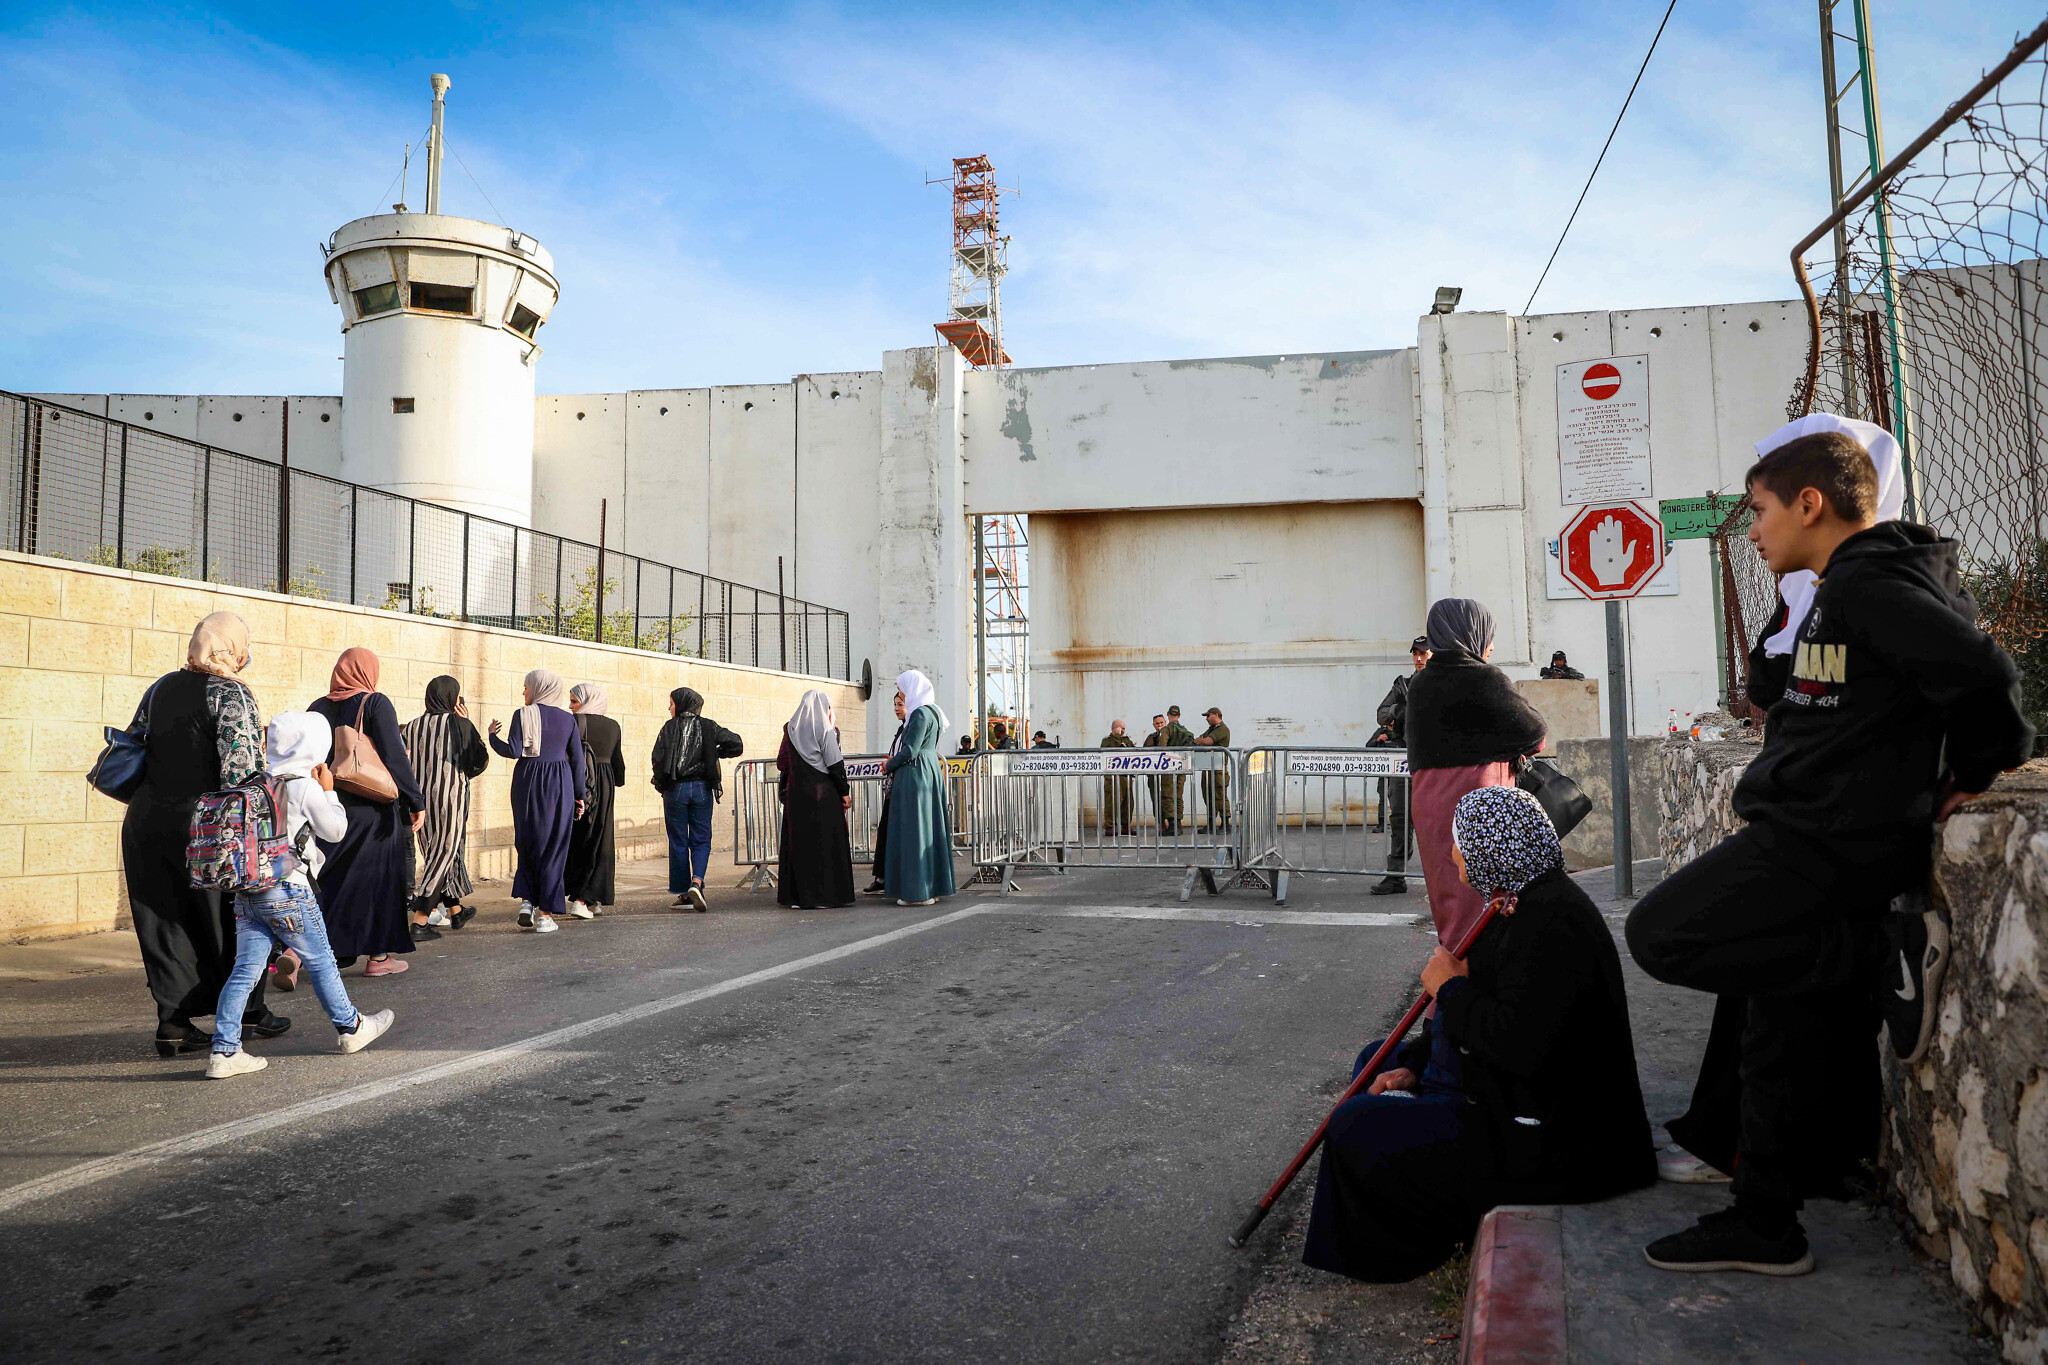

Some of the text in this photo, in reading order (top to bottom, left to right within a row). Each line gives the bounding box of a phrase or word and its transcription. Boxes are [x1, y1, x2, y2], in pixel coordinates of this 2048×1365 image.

[1816, 696, 1839, 708] 404
[1112, 756, 1152, 770] הבמה
[1154, 752, 1171, 770] על
[1292, 762, 1340, 772] 052-8204890
[847, 764, 880, 776] הבמה
